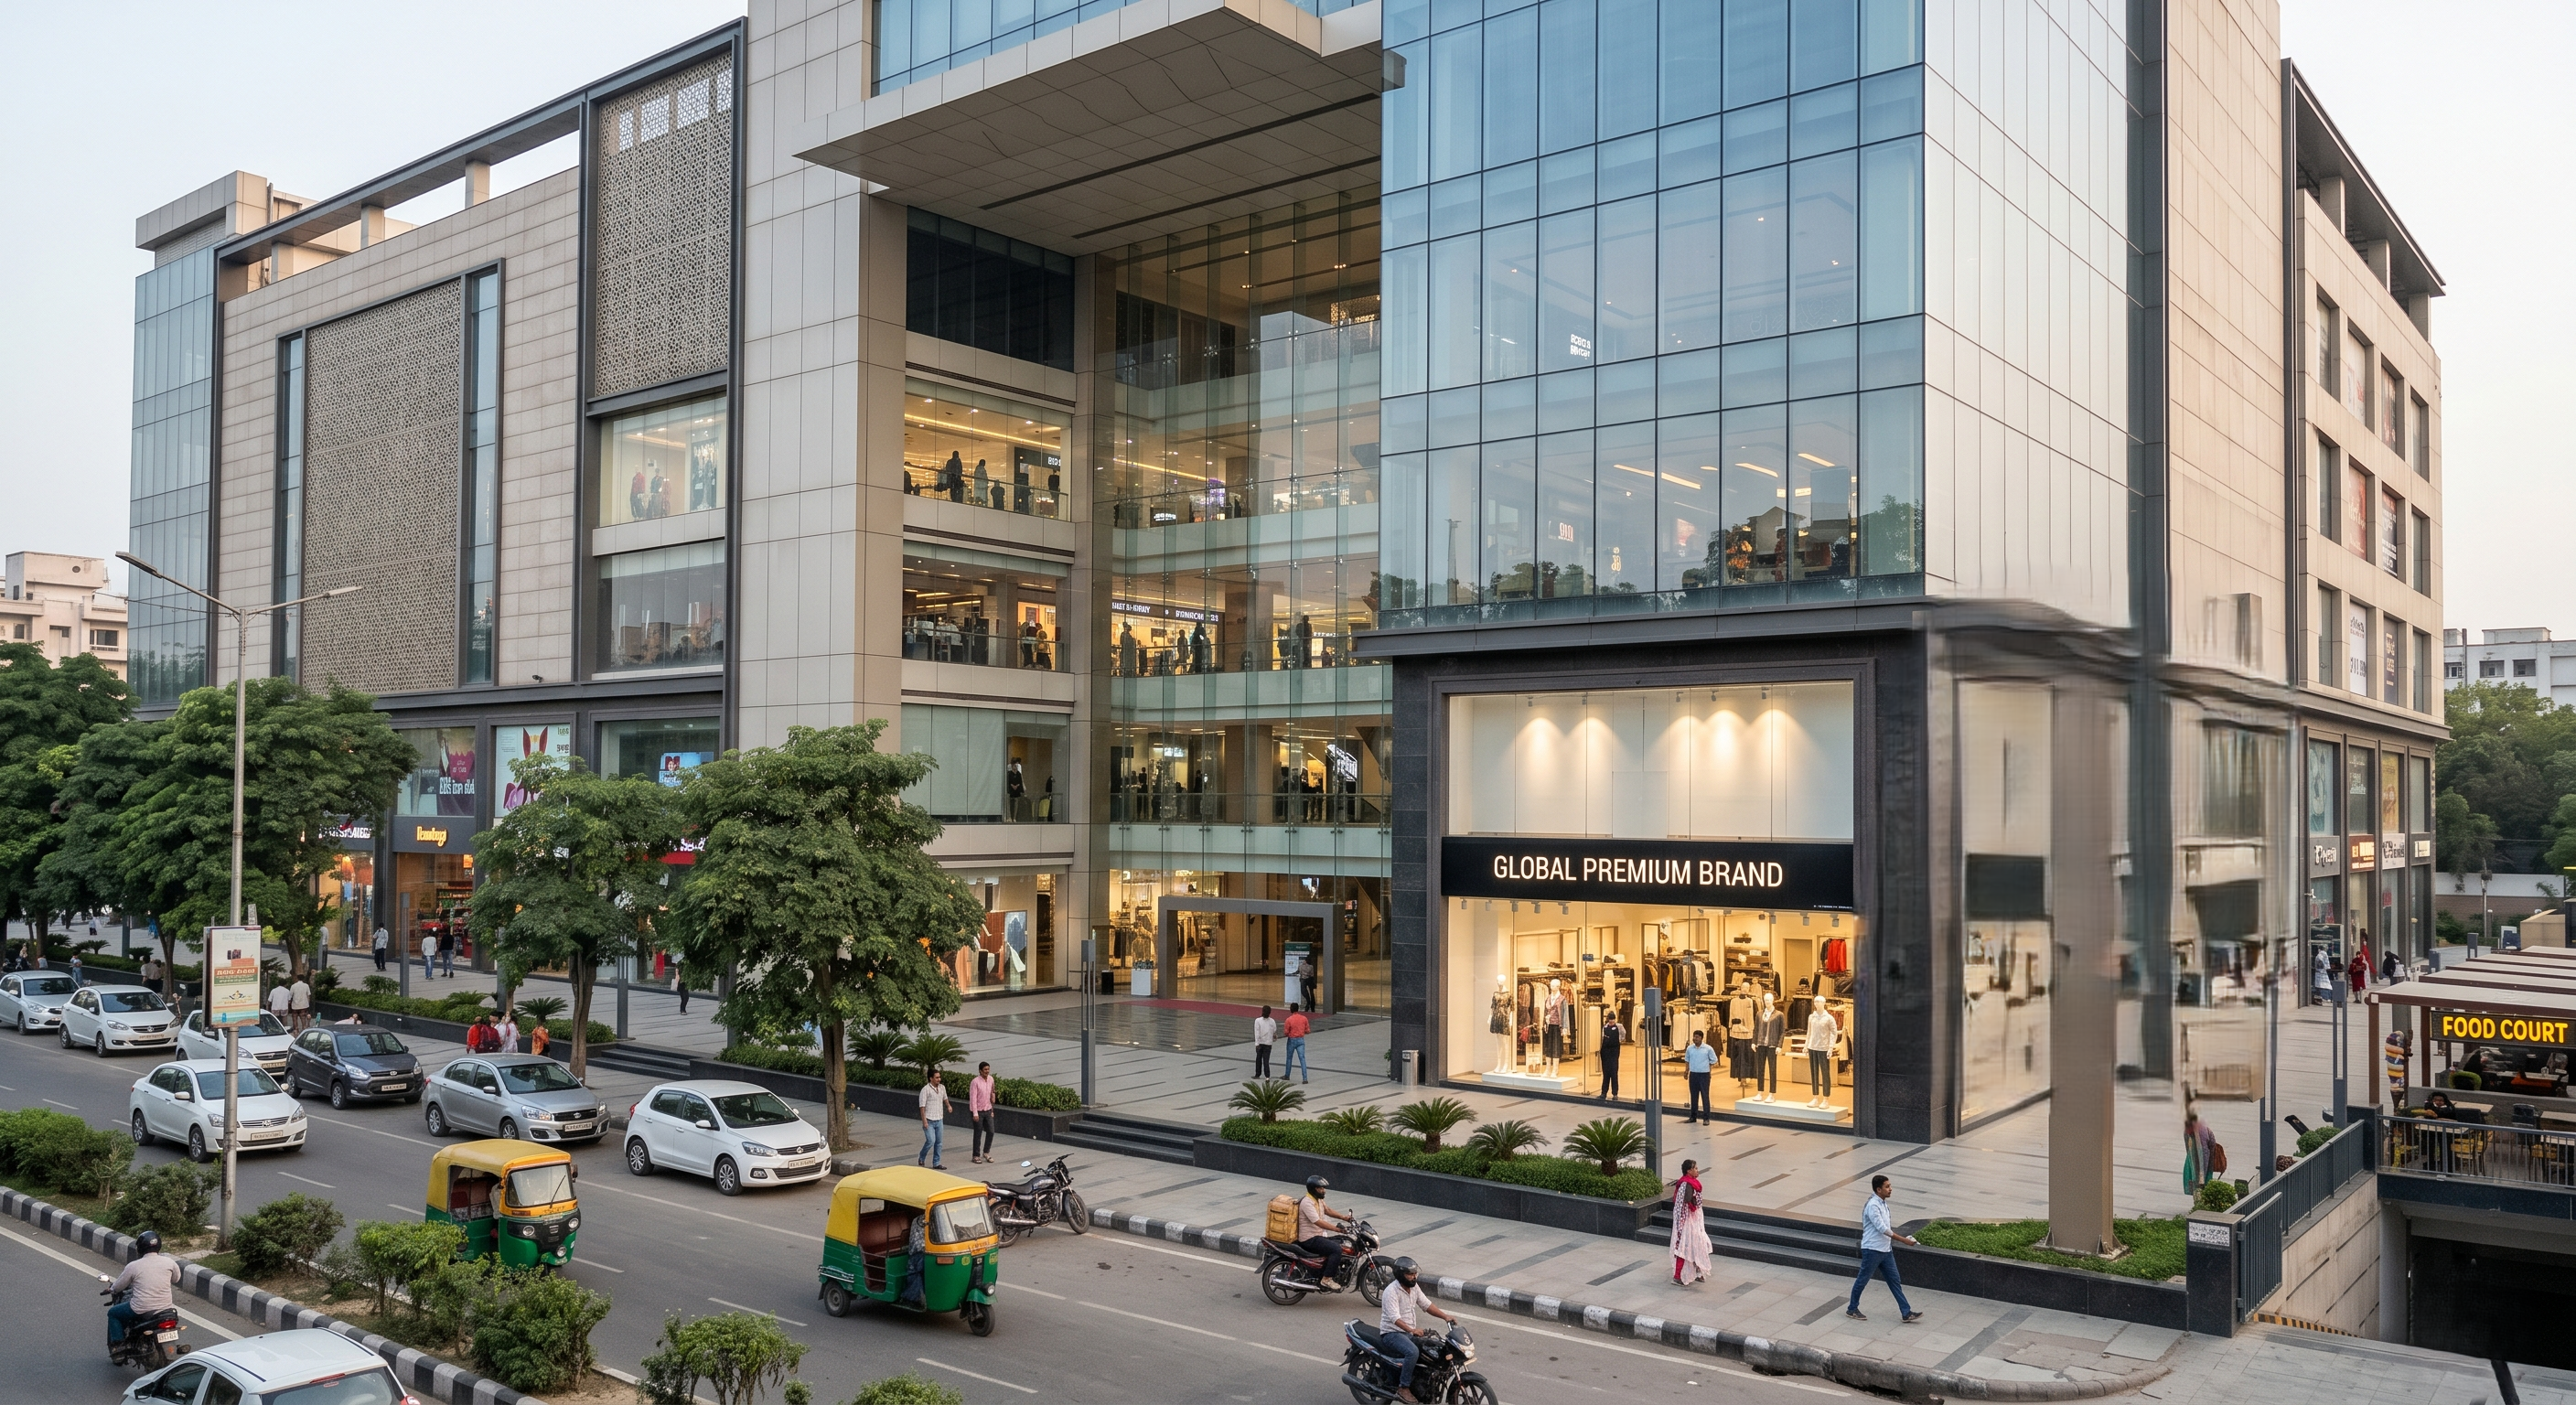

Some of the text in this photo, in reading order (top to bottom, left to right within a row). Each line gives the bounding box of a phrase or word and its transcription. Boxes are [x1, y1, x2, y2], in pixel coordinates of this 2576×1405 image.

[1494, 855, 1783, 887] GLOBAL PREMIUM BRAND
[2442, 1015, 2569, 1044] FOOD COURT
